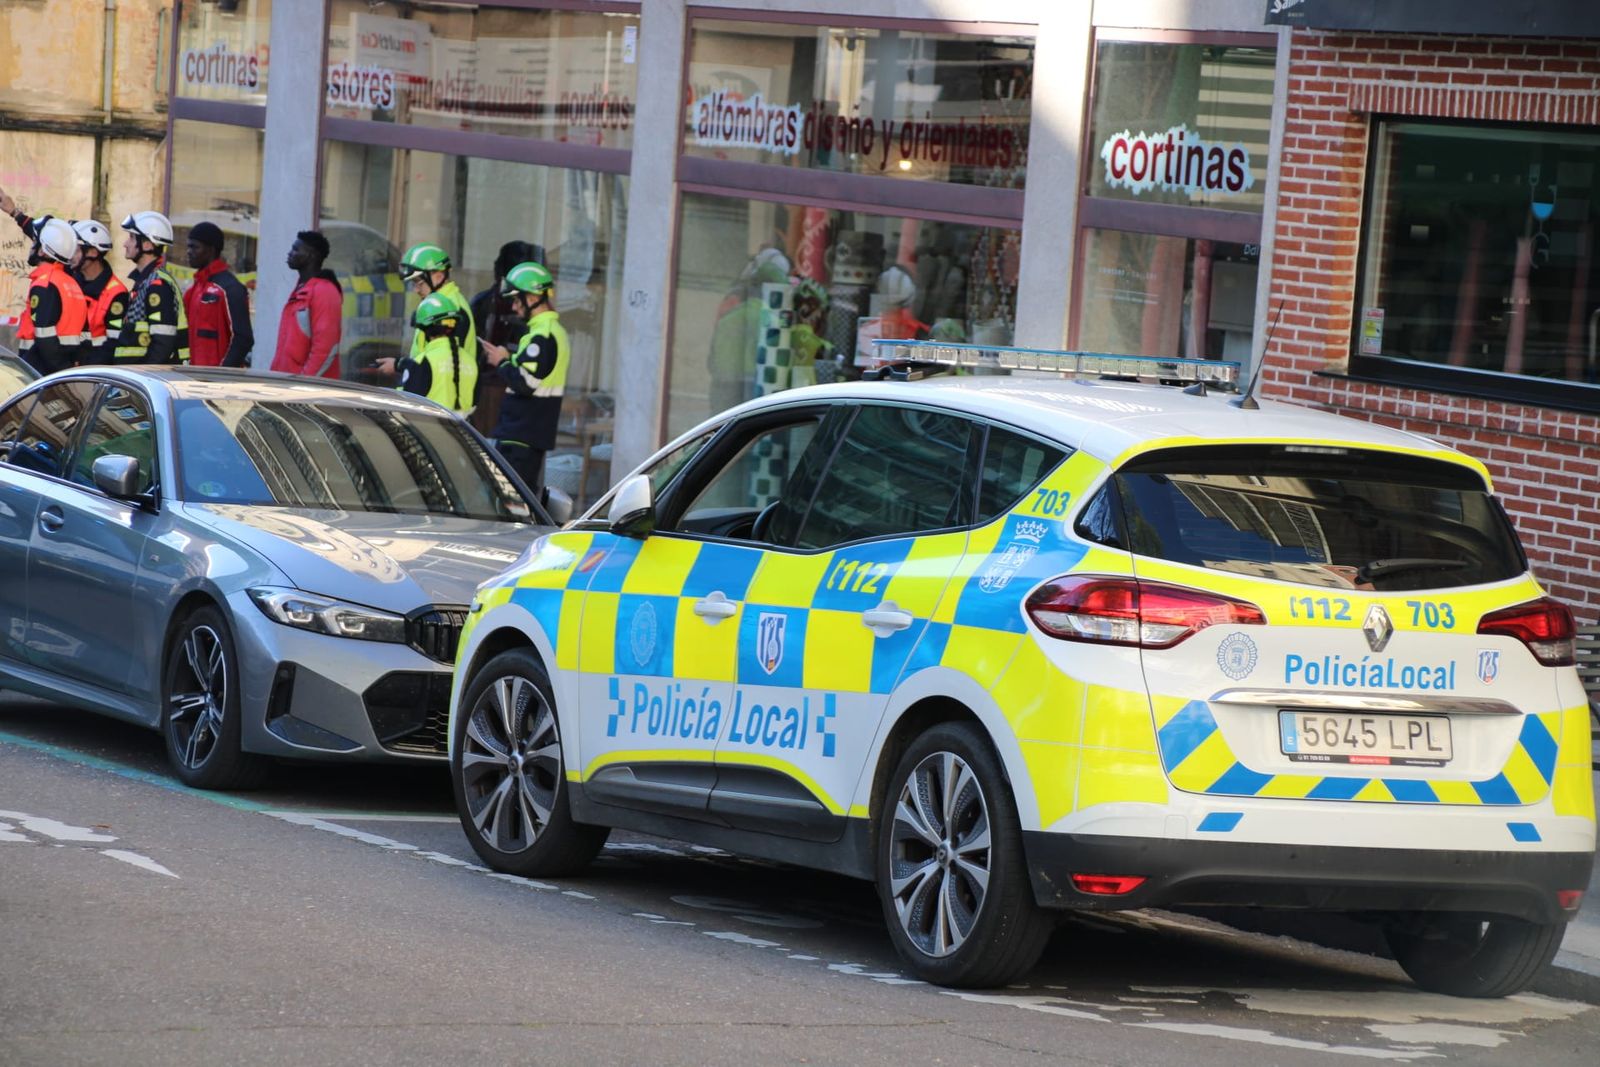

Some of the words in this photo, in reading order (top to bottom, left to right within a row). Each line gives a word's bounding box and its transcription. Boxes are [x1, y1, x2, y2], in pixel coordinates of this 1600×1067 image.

[186, 44, 258, 87] cortinas
[330, 63, 391, 106] stores
[698, 92, 797, 148] alfombras
[880, 119, 894, 170] y
[900, 110, 1013, 169] orientales
[1111, 131, 1245, 191] cortinas
[1031, 488, 1071, 517] 703
[837, 560, 889, 594] 112
[1299, 597, 1352, 621] 112
[1406, 600, 1456, 629] 703
[631, 682, 721, 740] Policía
[728, 690, 809, 750] Local
[1302, 716, 1378, 749] 5645
[1388, 720, 1443, 751] LPL
